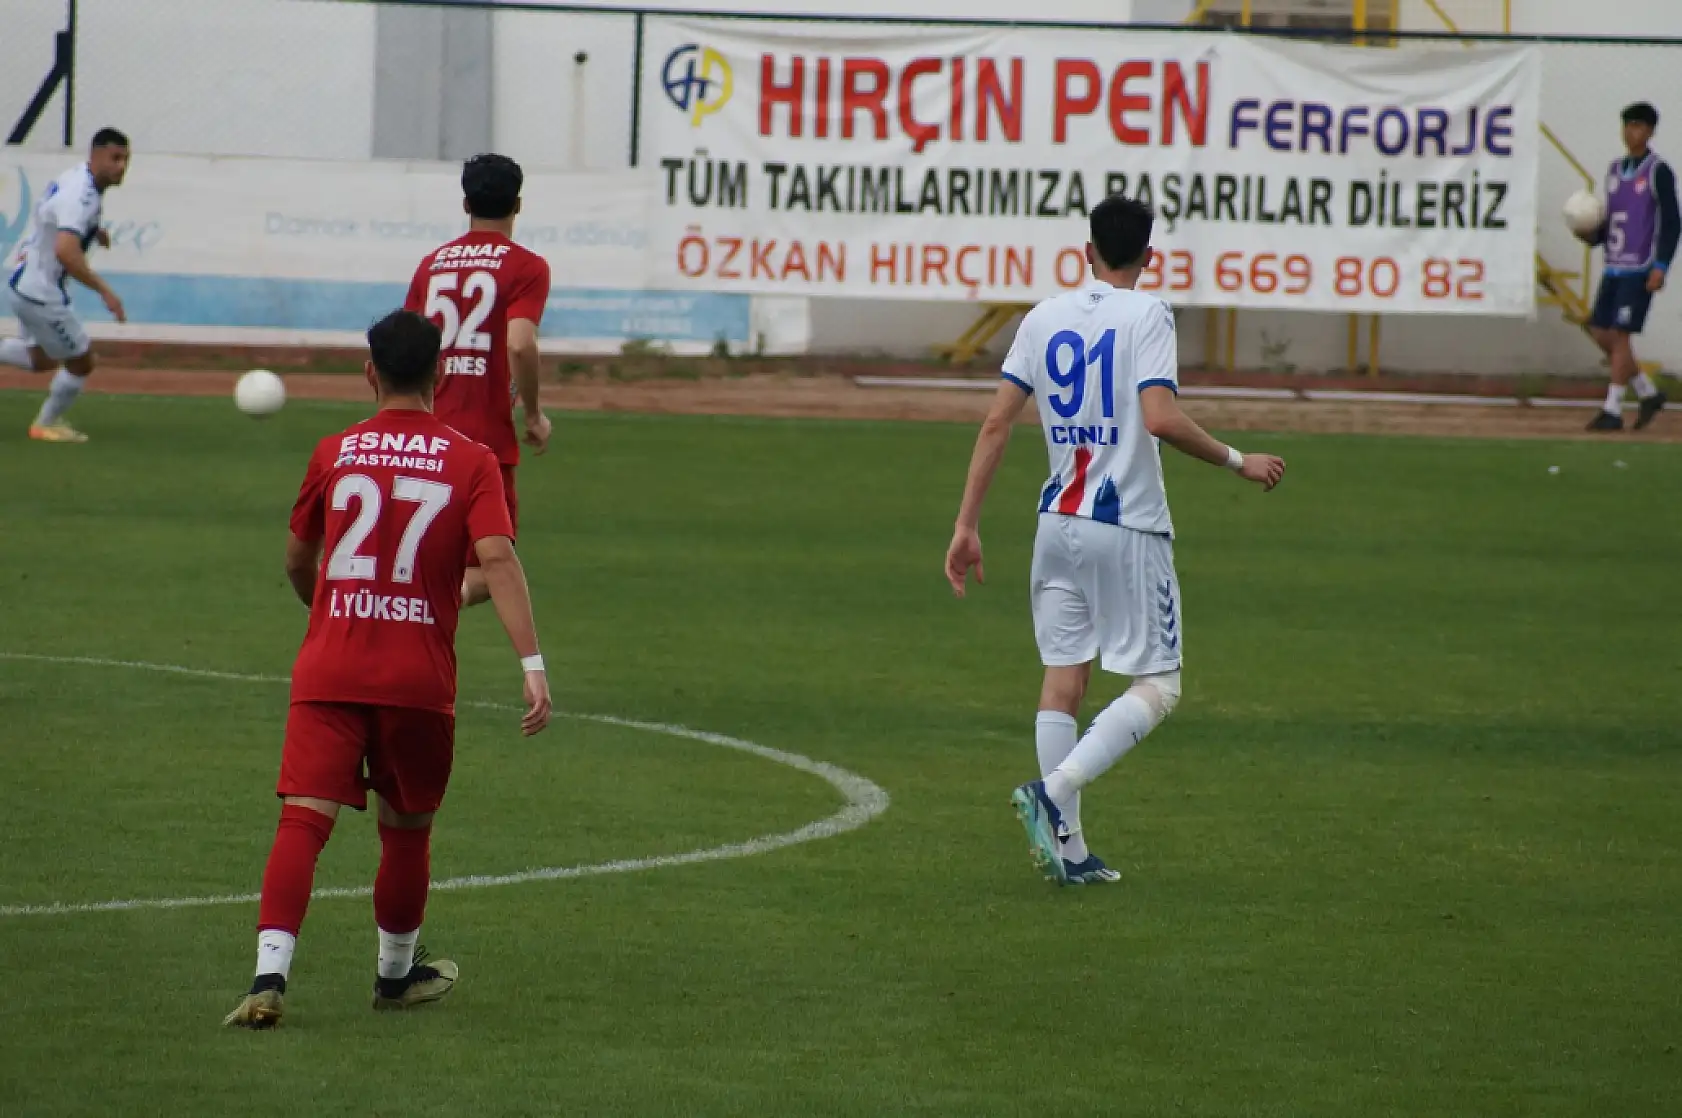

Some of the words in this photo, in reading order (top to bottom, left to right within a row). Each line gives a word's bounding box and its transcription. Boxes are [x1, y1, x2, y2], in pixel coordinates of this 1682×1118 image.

[759, 53, 1023, 155] HIRÇIN
[1053, 58, 1211, 147] PEN
[1229, 98, 1514, 157] FERFORJE
[660, 147, 749, 209] TÜM
[763, 162, 1088, 217] TAKIMLARIMIZA
[1347, 168, 1509, 229] DİLERİZ
[435, 243, 511, 260] ESNAF
[677, 225, 847, 285] ÖZKAN
[869, 243, 1033, 299] HIRÇIN
[1214, 251, 1312, 296] 669
[1334, 256, 1400, 298] 80
[1422, 256, 1486, 300] 82
[1607, 210, 1630, 253] 5
[424, 270, 498, 351] 52
[1046, 328, 1116, 418] 91
[340, 431, 451, 456] ESNAF
[326, 473, 453, 584] 27
